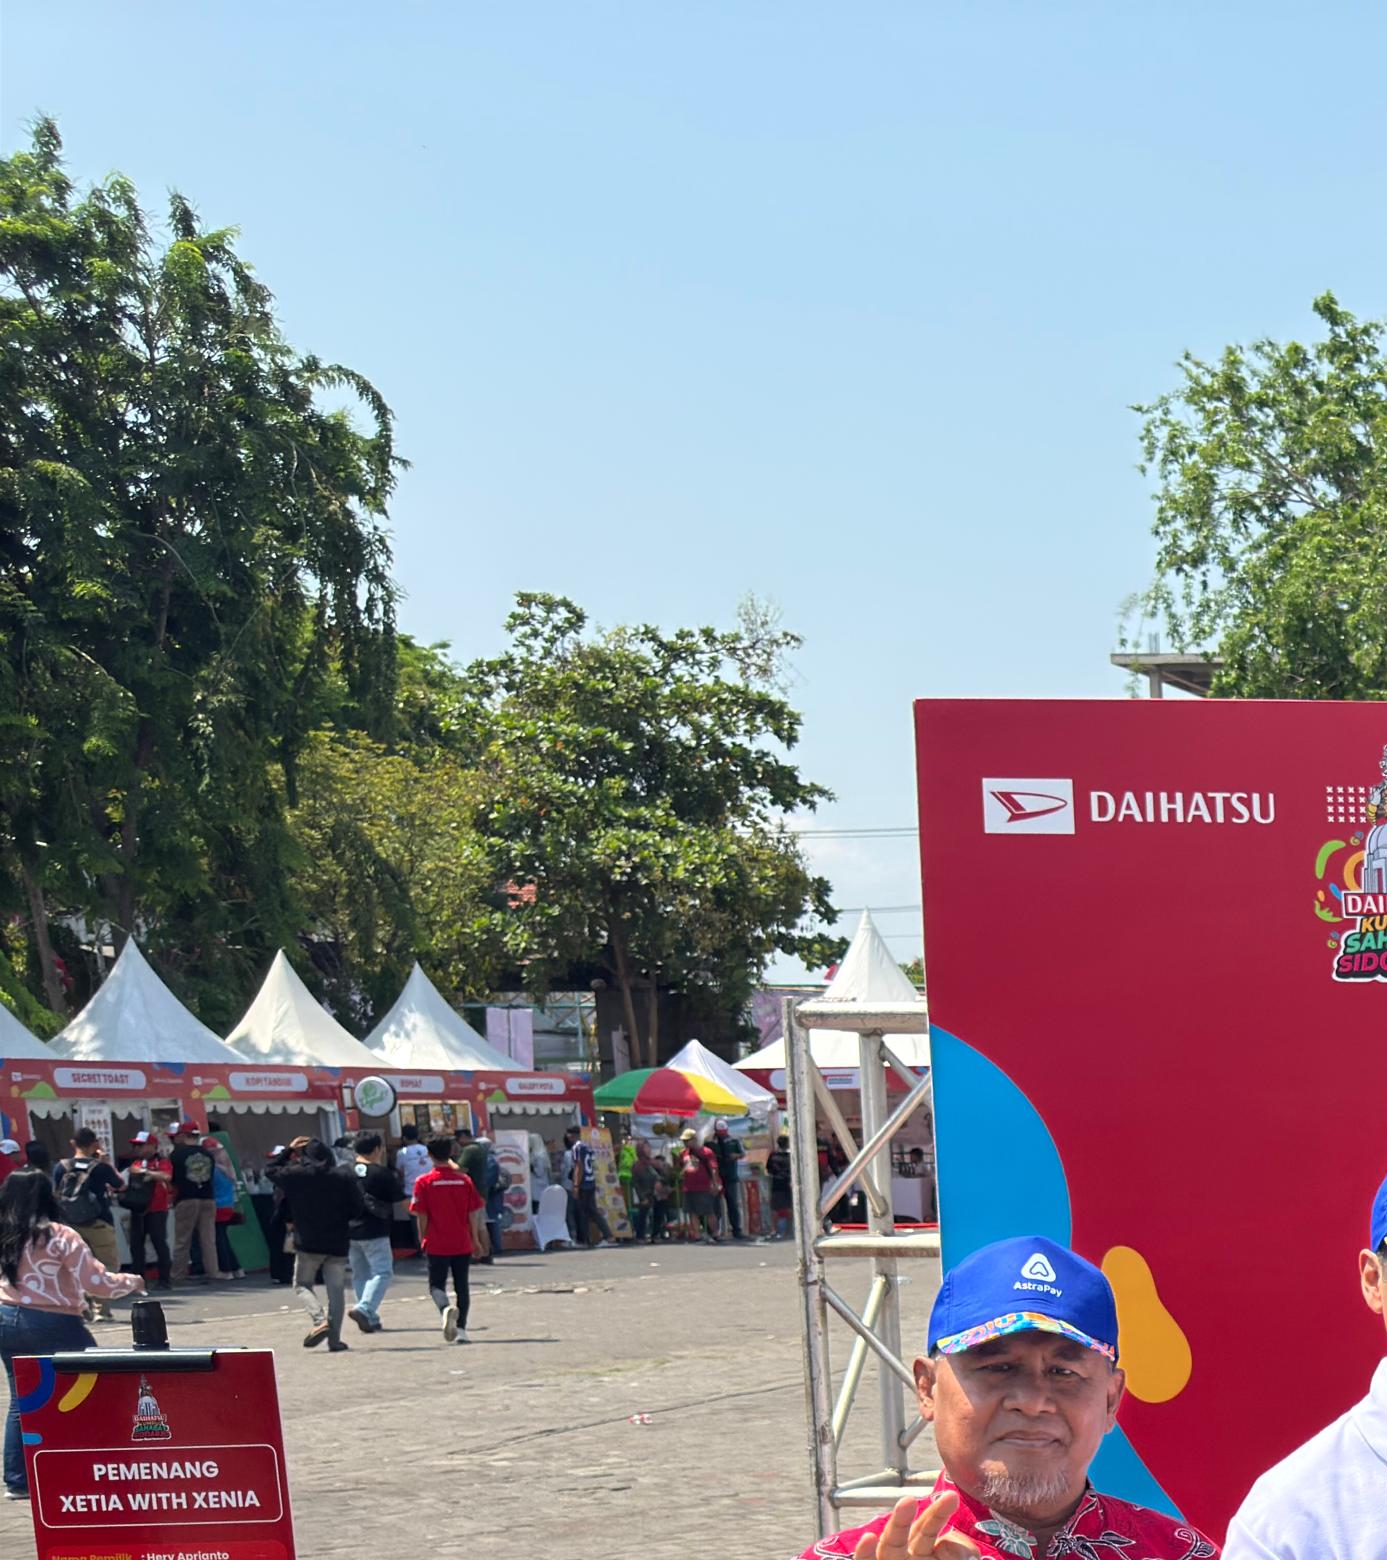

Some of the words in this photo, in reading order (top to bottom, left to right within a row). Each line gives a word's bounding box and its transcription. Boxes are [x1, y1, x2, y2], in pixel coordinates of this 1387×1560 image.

[1090, 791, 1276, 824] DAIHATSU
[1013, 1281, 1062, 1298] AstraPay
[93, 1461, 219, 1481] PEMENANG
[60, 1494, 123, 1512] XETIA
[127, 1492, 188, 1511] WITH
[192, 1490, 261, 1509] XENIA
